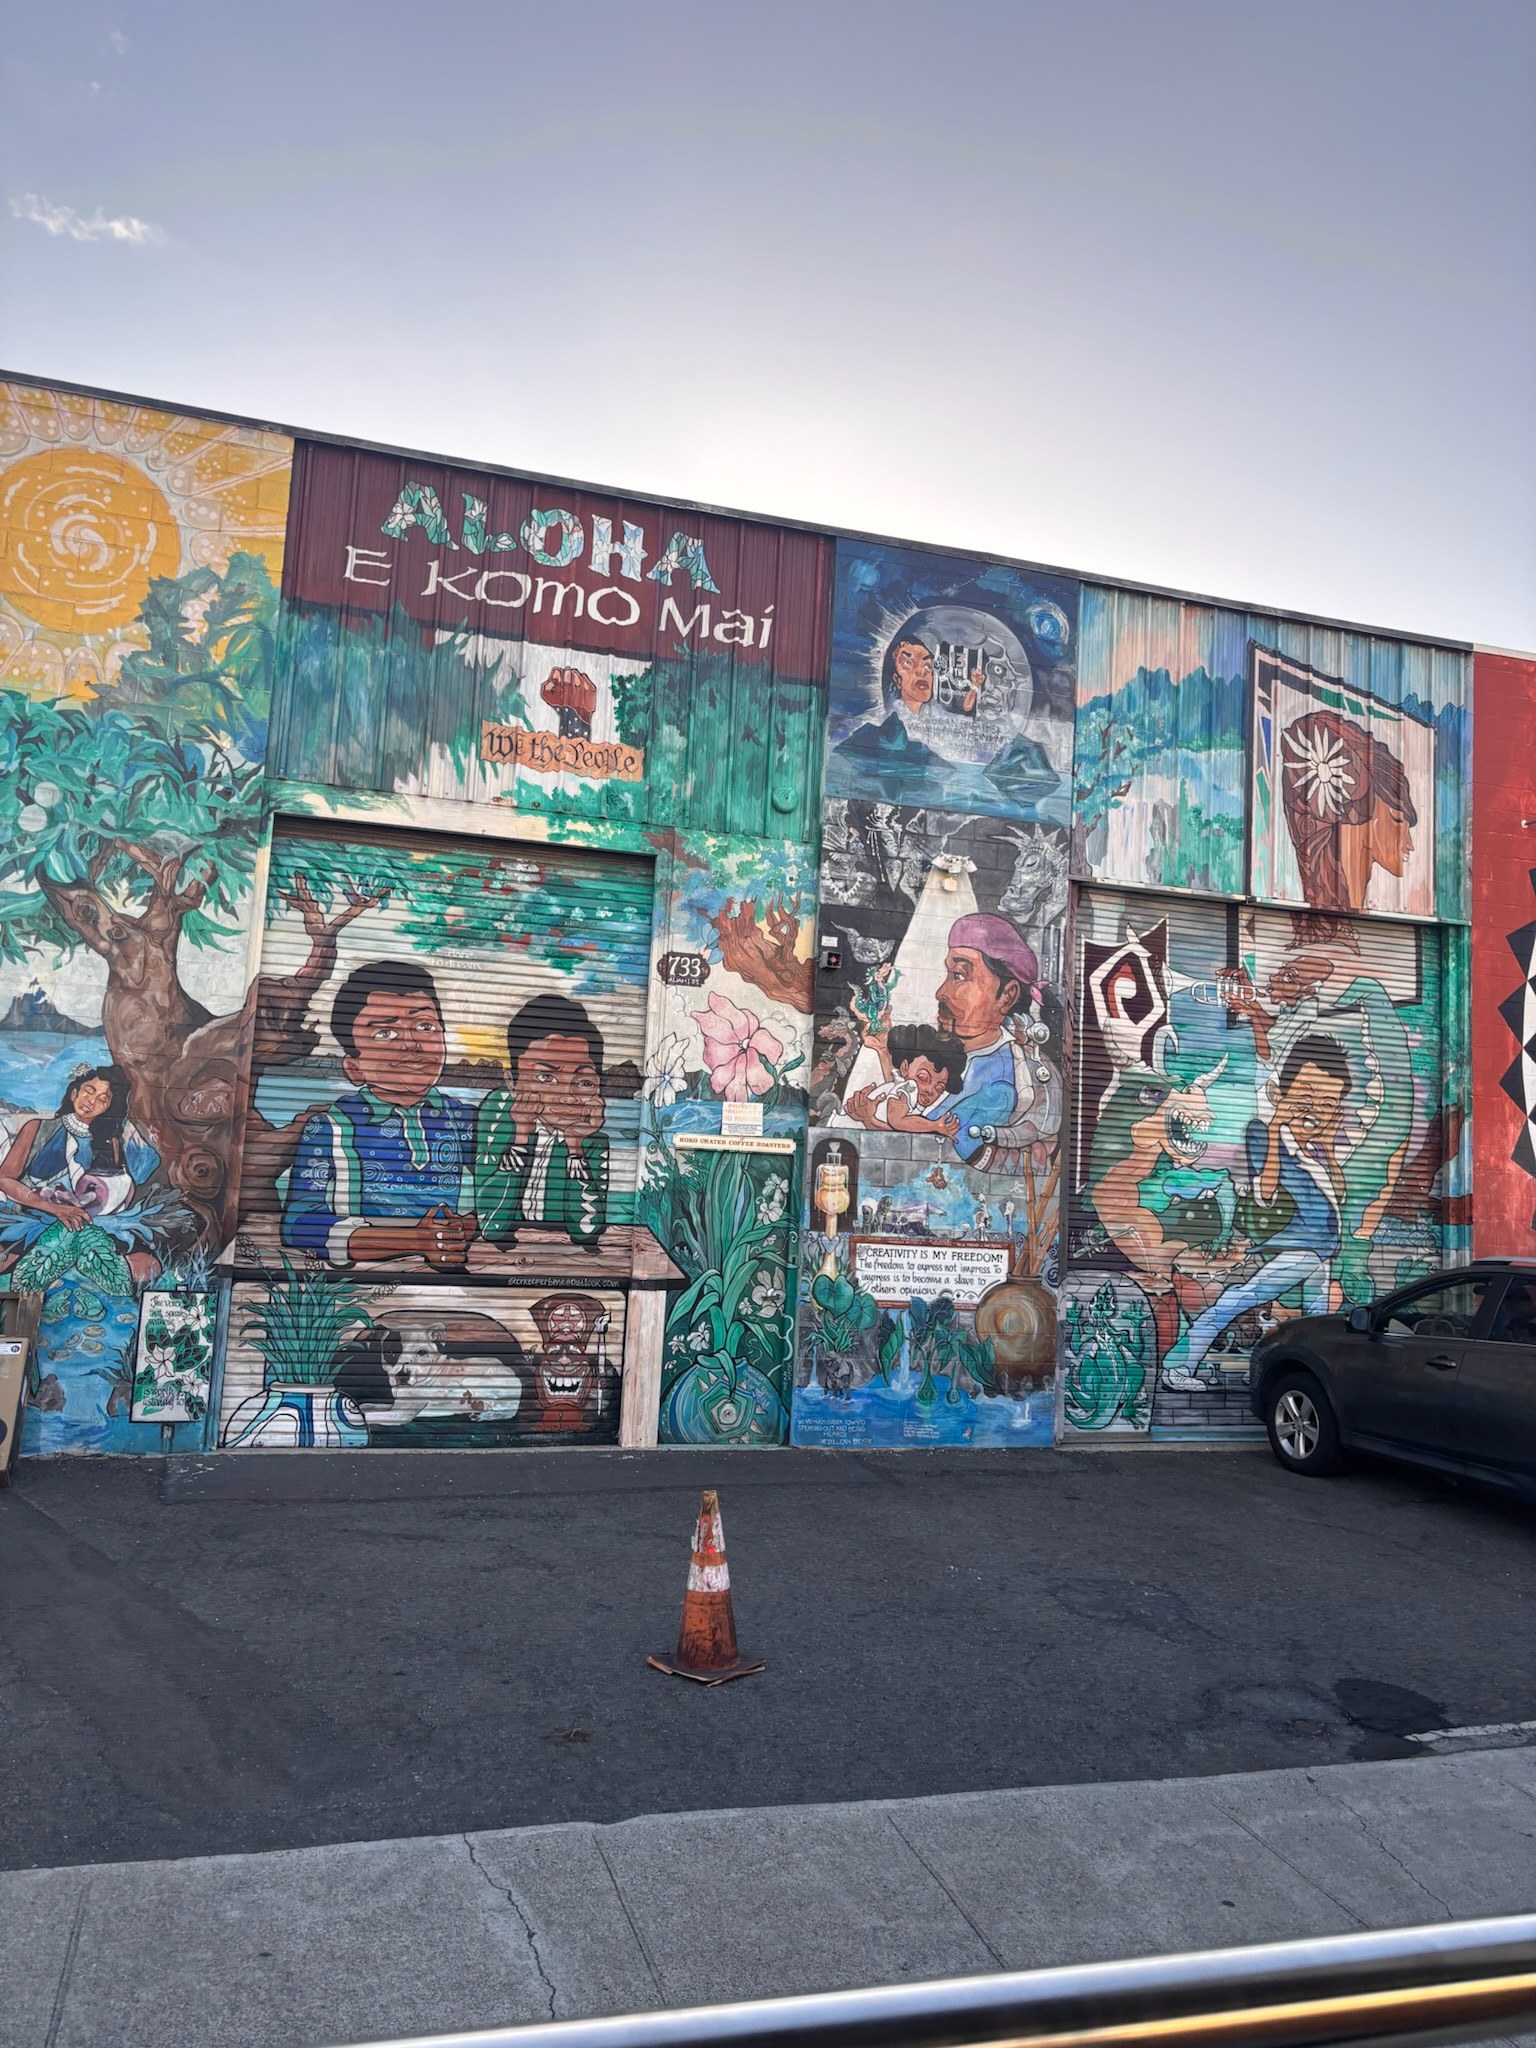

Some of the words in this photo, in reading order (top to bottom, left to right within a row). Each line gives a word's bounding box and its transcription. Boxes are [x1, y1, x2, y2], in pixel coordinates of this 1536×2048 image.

[381, 480, 721, 594] ALOHA
[344, 545, 392, 588] E
[659, 596, 775, 648] Mai
[484, 727, 526, 760] We
[529, 735, 566, 768] the
[563, 740, 639, 775] People
[668, 955, 701, 978] 733
[756, 1141, 791, 1149] ROASTERS
[866, 1247, 918, 1259] CREATIVITY
[920, 1249, 929, 1259] IS
[932, 1250, 947, 1261] MY
[951, 1251, 1004, 1264] FREEDOM!
[858, 1258, 873, 1270] The
[873, 1258, 905, 1271] freedom
[907, 1260, 915, 1271] to
[917, 1262, 943, 1274] express
[944, 1261, 958, 1273] not
[993, 1263, 1002, 1275] To
[861, 1273, 891, 1285] impress
[893, 1272, 900, 1282] is
[902, 1273, 911, 1283] to
[912, 1272, 942, 1285] become
[944, 1276, 950, 1285] a
[954, 1273, 975, 1286] slave
[978, 1275, 987, 1287] to
[870, 1282, 897, 1295] others
